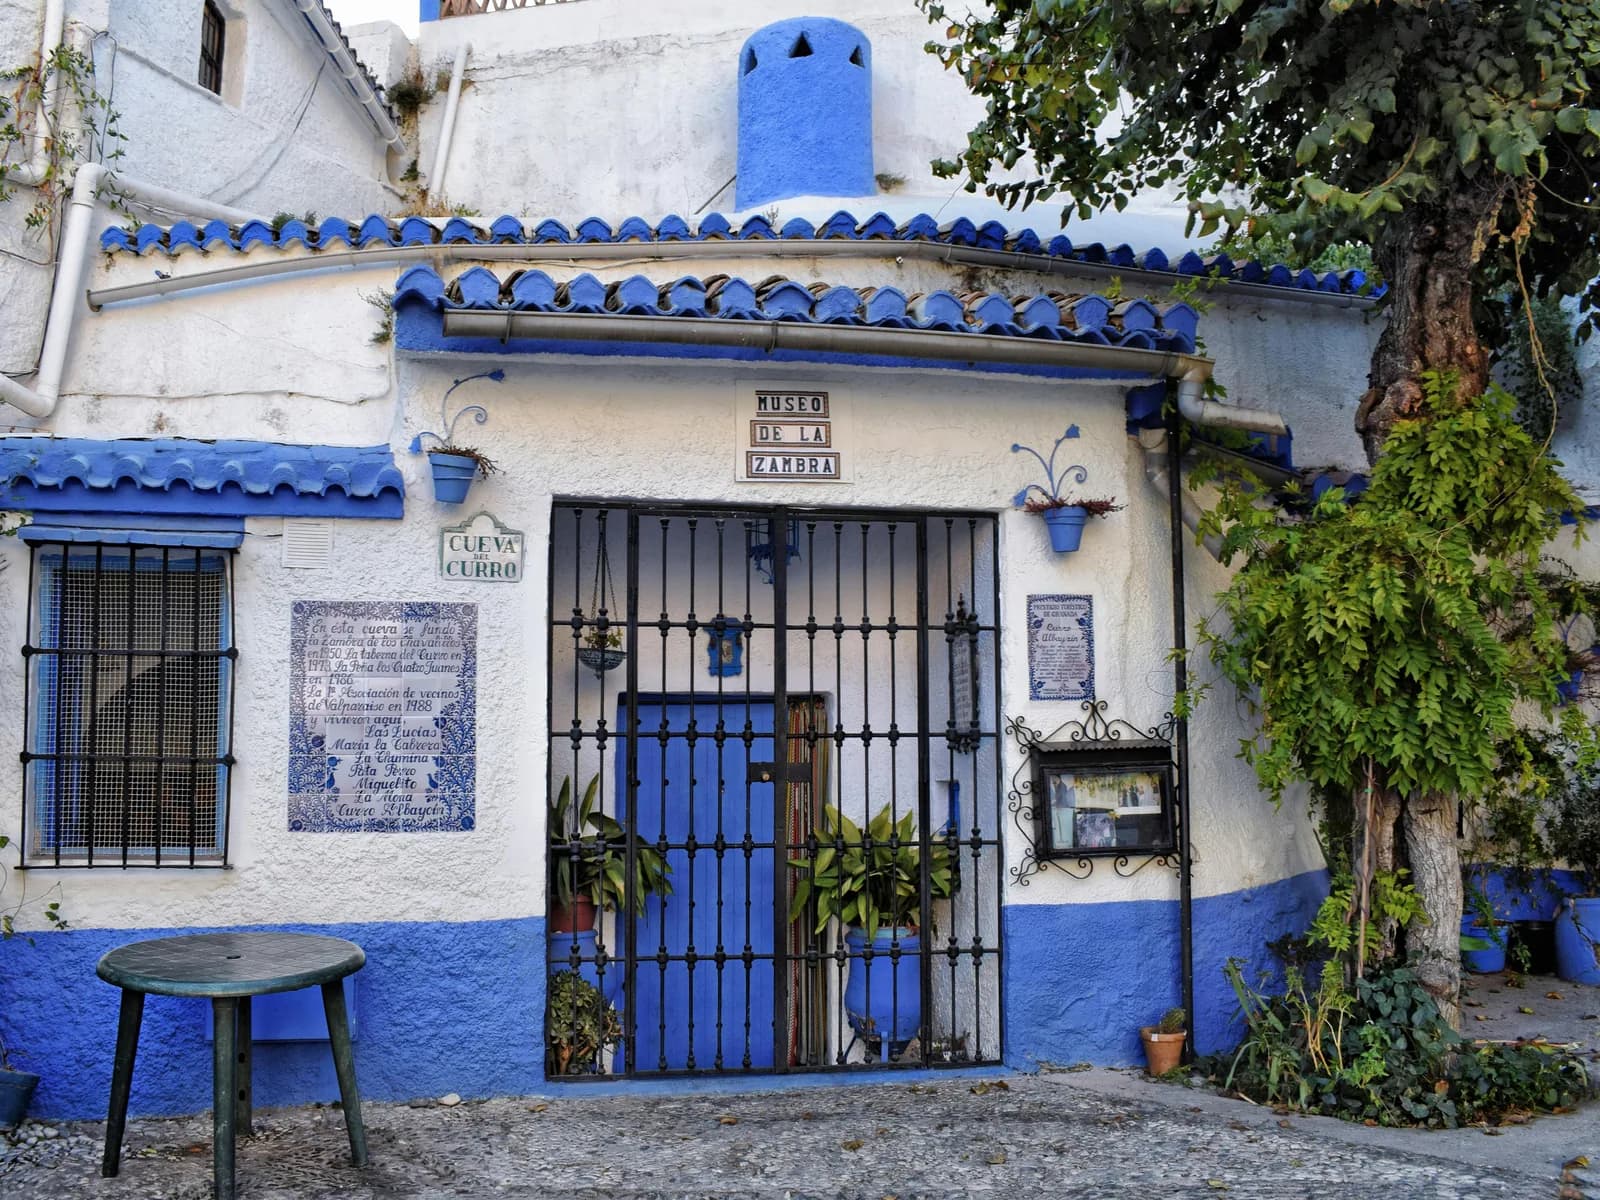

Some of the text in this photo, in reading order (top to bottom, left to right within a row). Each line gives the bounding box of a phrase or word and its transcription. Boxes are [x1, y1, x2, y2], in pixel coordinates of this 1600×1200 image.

[757, 396, 821, 412] MUSEO
[759, 426, 823, 442] DE LA
[755, 456, 832, 473] ZAMBRA
[449, 535, 517, 553] CUEVA
[447, 560, 517, 578] CURRO
[312, 618, 327, 634] En
[362, 625, 398, 634] cueva
[403, 625, 414, 634] se
[308, 634, 319, 646] la
[321, 634, 364, 646] Zambra
[367, 635, 379, 647] de
[381, 635, 397, 647] los
[344, 648, 358, 660] La
[360, 648, 397, 660] taberna
[400, 648, 414, 660] del
[417, 648, 448, 660] Curro
[450, 652, 462, 660] en
[333, 660, 348, 672] La
[350, 660, 374, 672] Peña
[376, 660, 391, 672] los
[392, 660, 424, 672] Cuatro
[424, 660, 460, 675] Juanes
[308, 673, 354, 685] en 1986
[306, 685, 322, 697] La
[339, 686, 399, 698] Asociación
[403, 687, 416, 698] de
[420, 690, 460, 698] vecinos
[308, 699, 322, 710] de
[388, 703, 402, 712] en
[406, 700, 432, 712] 1988
[310, 716, 318, 729] y
[324, 714, 370, 724] vivieron
[365, 724, 389, 738] Las
[375, 738, 386, 750] la
[392, 738, 440, 750] Cabrera
[354, 751, 371, 764] La
[384, 764, 416, 778] Perro
[352, 778, 417, 794] Miguelito
[354, 790, 413, 803] La Mona
[336, 804, 376, 816] Curro
